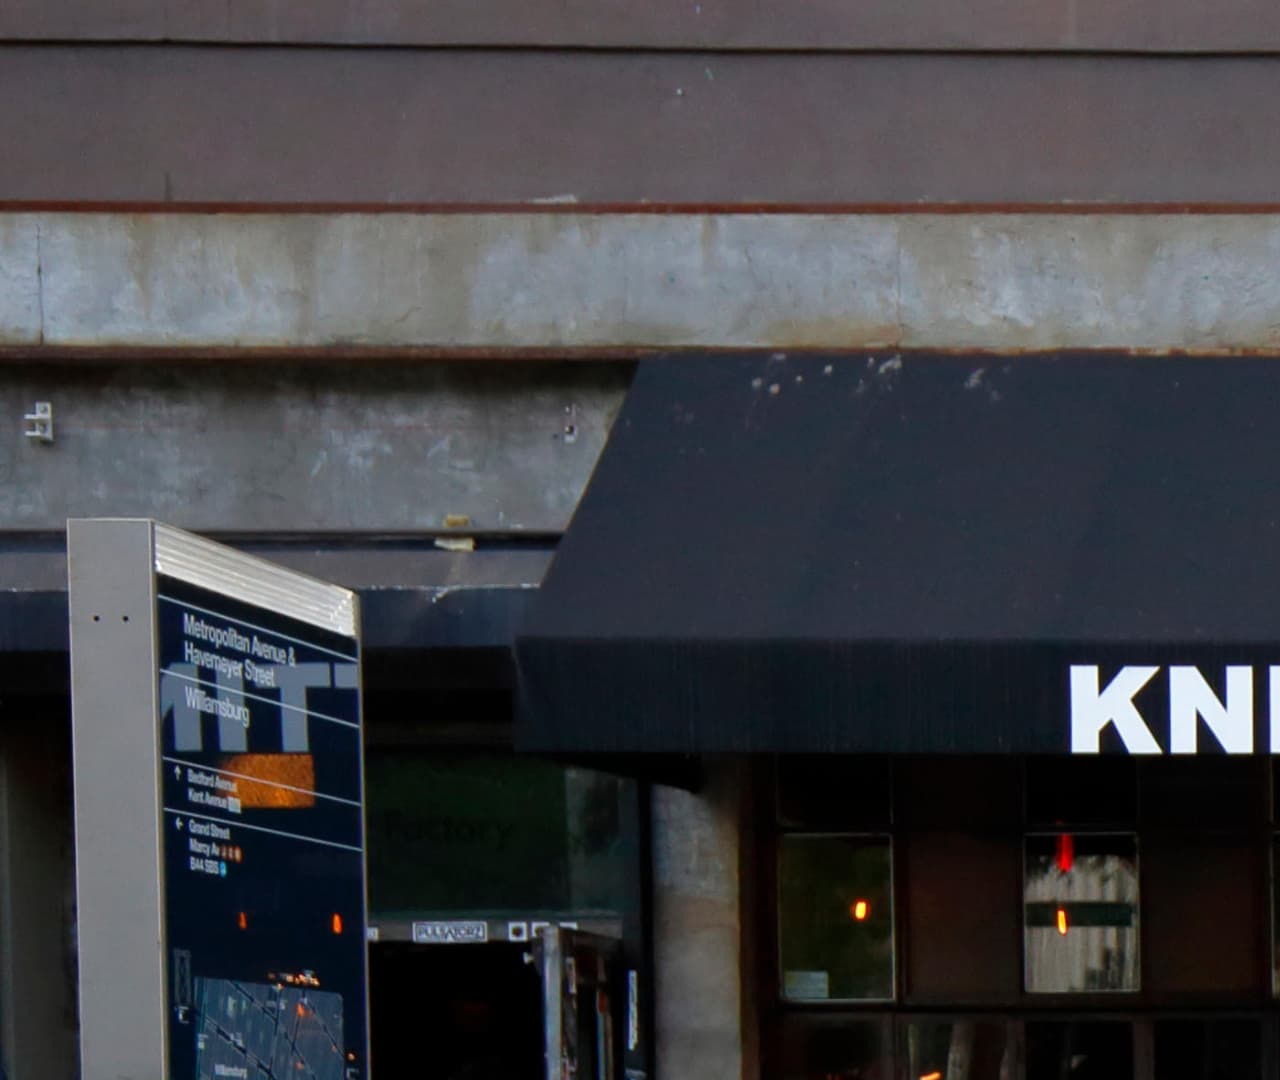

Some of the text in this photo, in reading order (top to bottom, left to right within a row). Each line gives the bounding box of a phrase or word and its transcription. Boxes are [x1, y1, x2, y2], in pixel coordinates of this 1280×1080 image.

[183, 612, 296, 668] Metropolitan Avenue &
[184, 640, 276, 687] Havemeyer Street
[185, 686, 250, 729] Williamsburg
